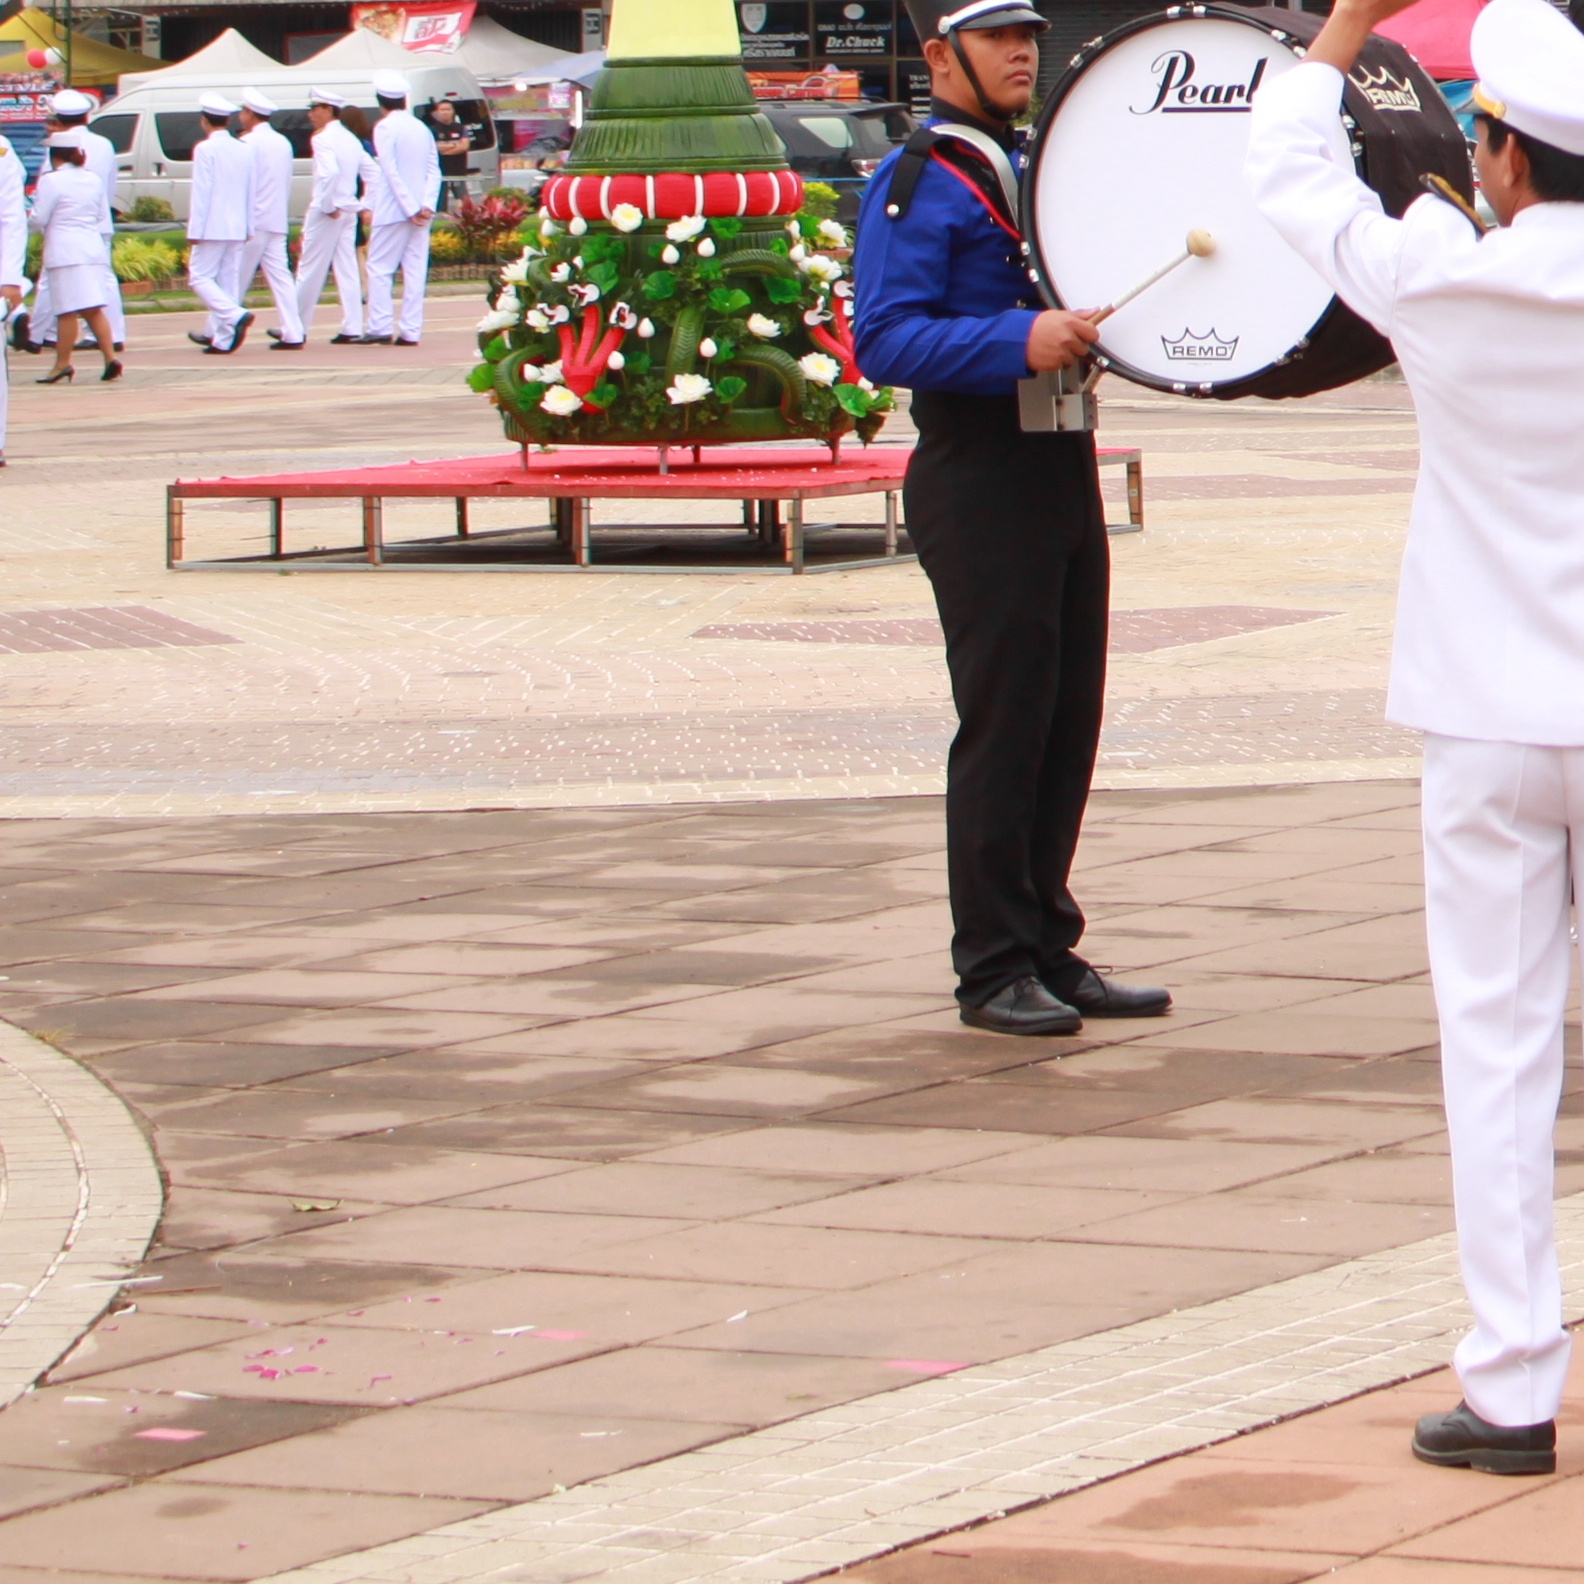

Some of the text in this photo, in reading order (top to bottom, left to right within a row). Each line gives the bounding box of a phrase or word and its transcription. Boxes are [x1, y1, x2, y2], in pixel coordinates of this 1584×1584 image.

[825, 35, 886, 48] Dr.Chuck
[1129, 49, 1269, 115] Pearl
[1172, 345, 1228, 357] REMO
